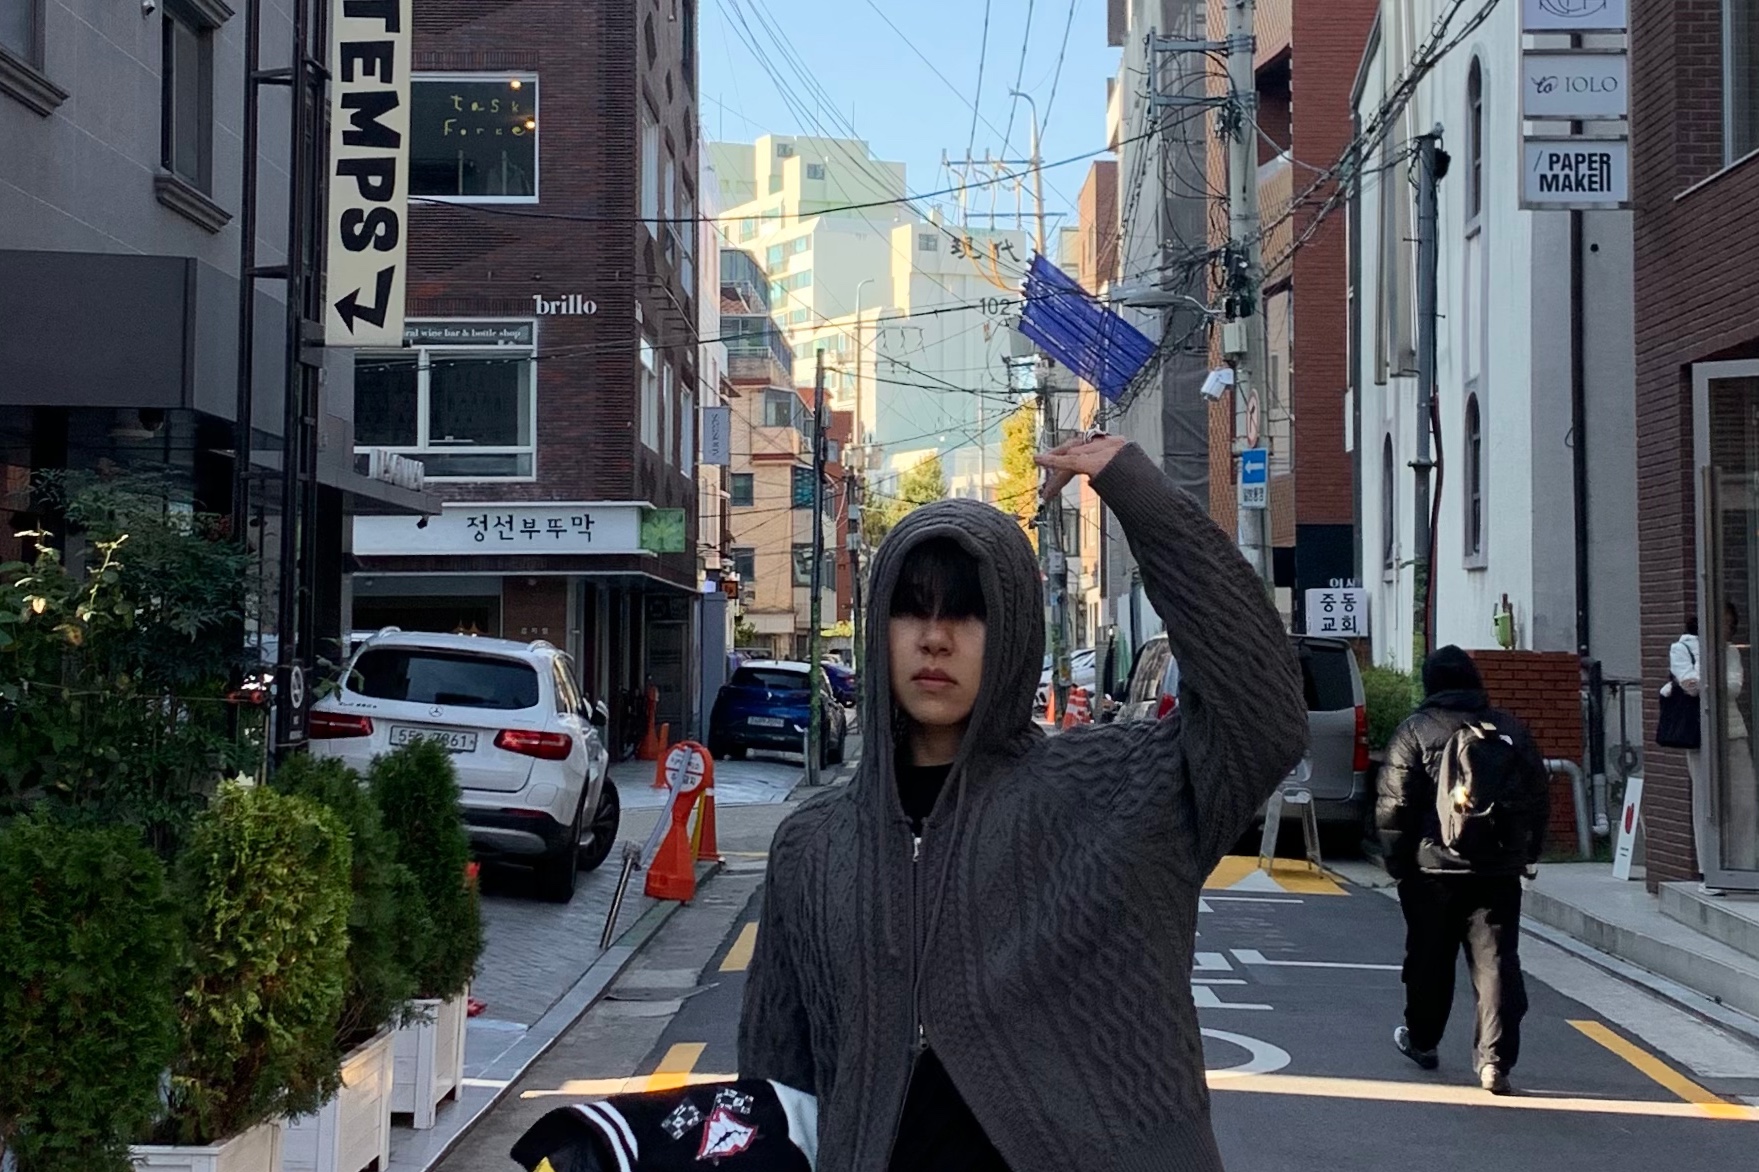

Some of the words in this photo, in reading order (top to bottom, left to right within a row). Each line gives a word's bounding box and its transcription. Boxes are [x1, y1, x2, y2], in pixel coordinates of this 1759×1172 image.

[1565, 76, 1618, 93] IOLO
[336, 0, 402, 252] TEMPS
[1548, 152, 1611, 173] PAPER
[533, 294, 597, 315] brillo
[979, 297, 1010, 315] 102
[444, 328, 460, 337] bar
[467, 513, 595, 543] 정선부뚜막
[1320, 593, 1357, 613] 중동
[1320, 615, 1357, 633] 교회
